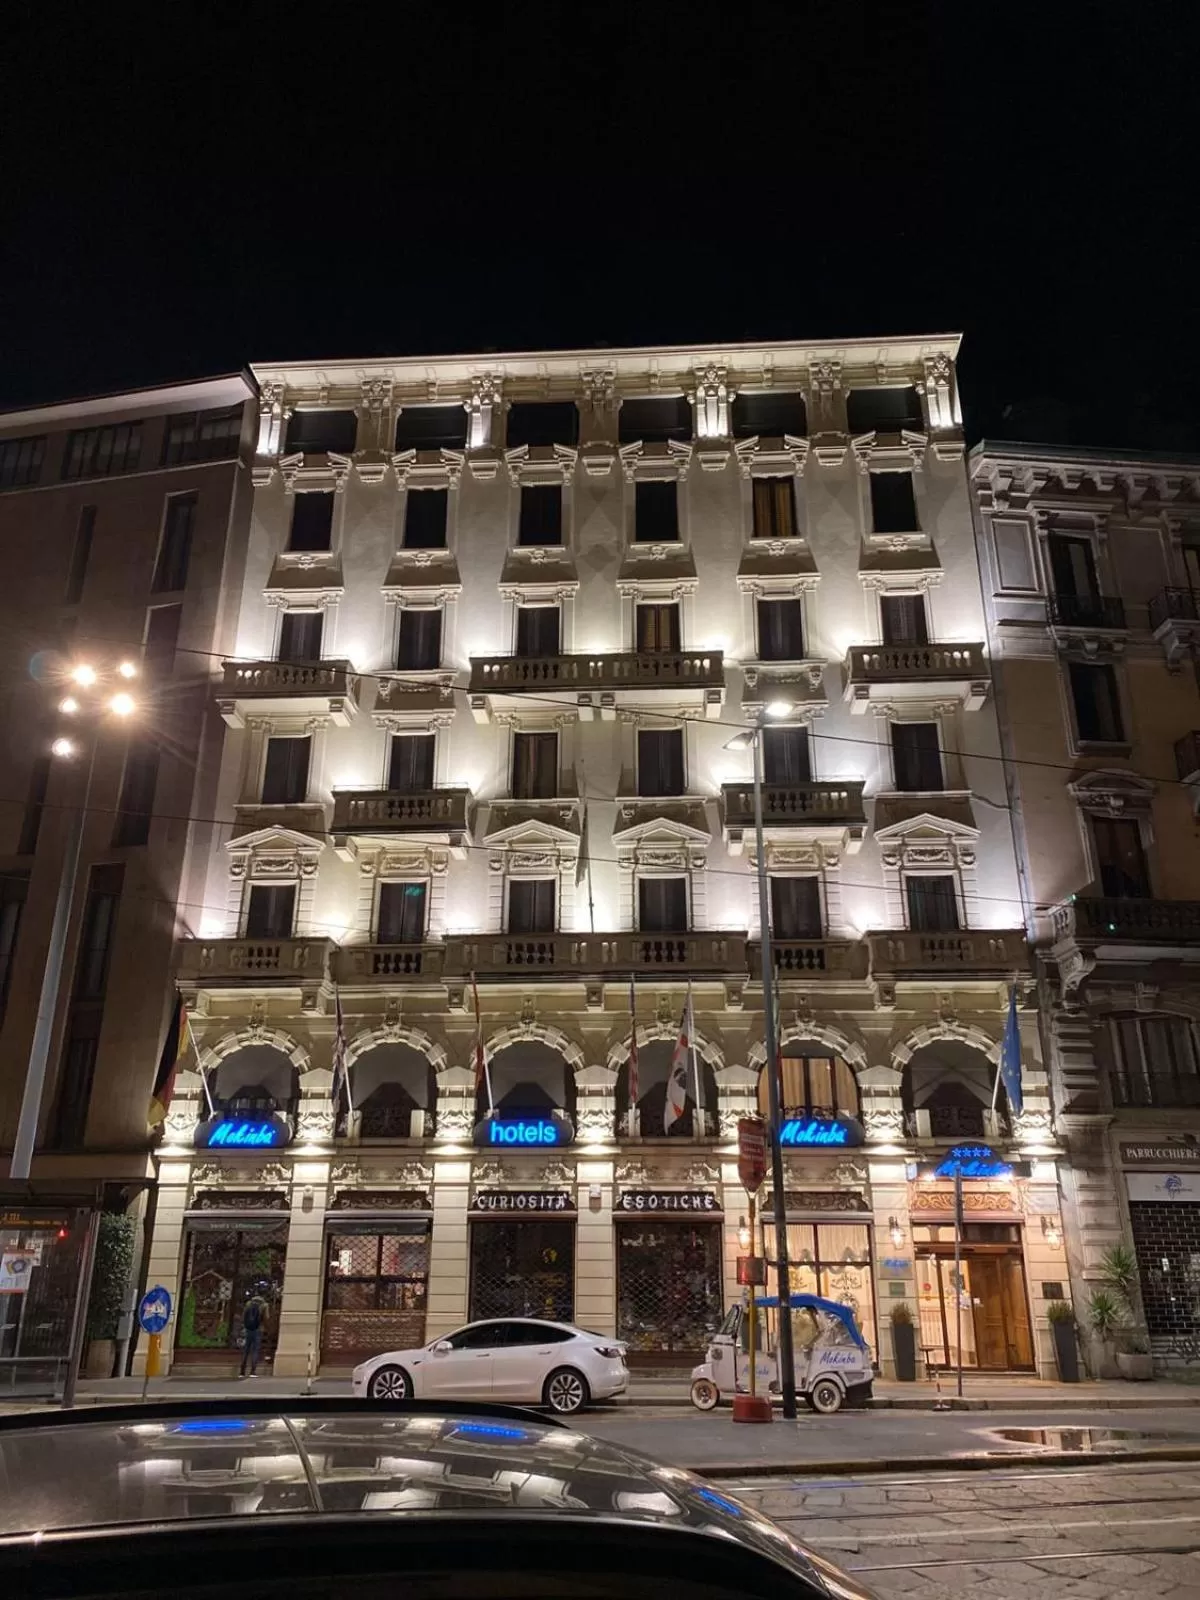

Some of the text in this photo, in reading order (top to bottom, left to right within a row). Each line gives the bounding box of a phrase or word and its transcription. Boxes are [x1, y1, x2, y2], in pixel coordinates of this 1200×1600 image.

[490, 1121, 557, 1143] hotels
[622, 1194, 714, 1209] ESOTICHE
[819, 1351, 856, 1365] Mokinba
